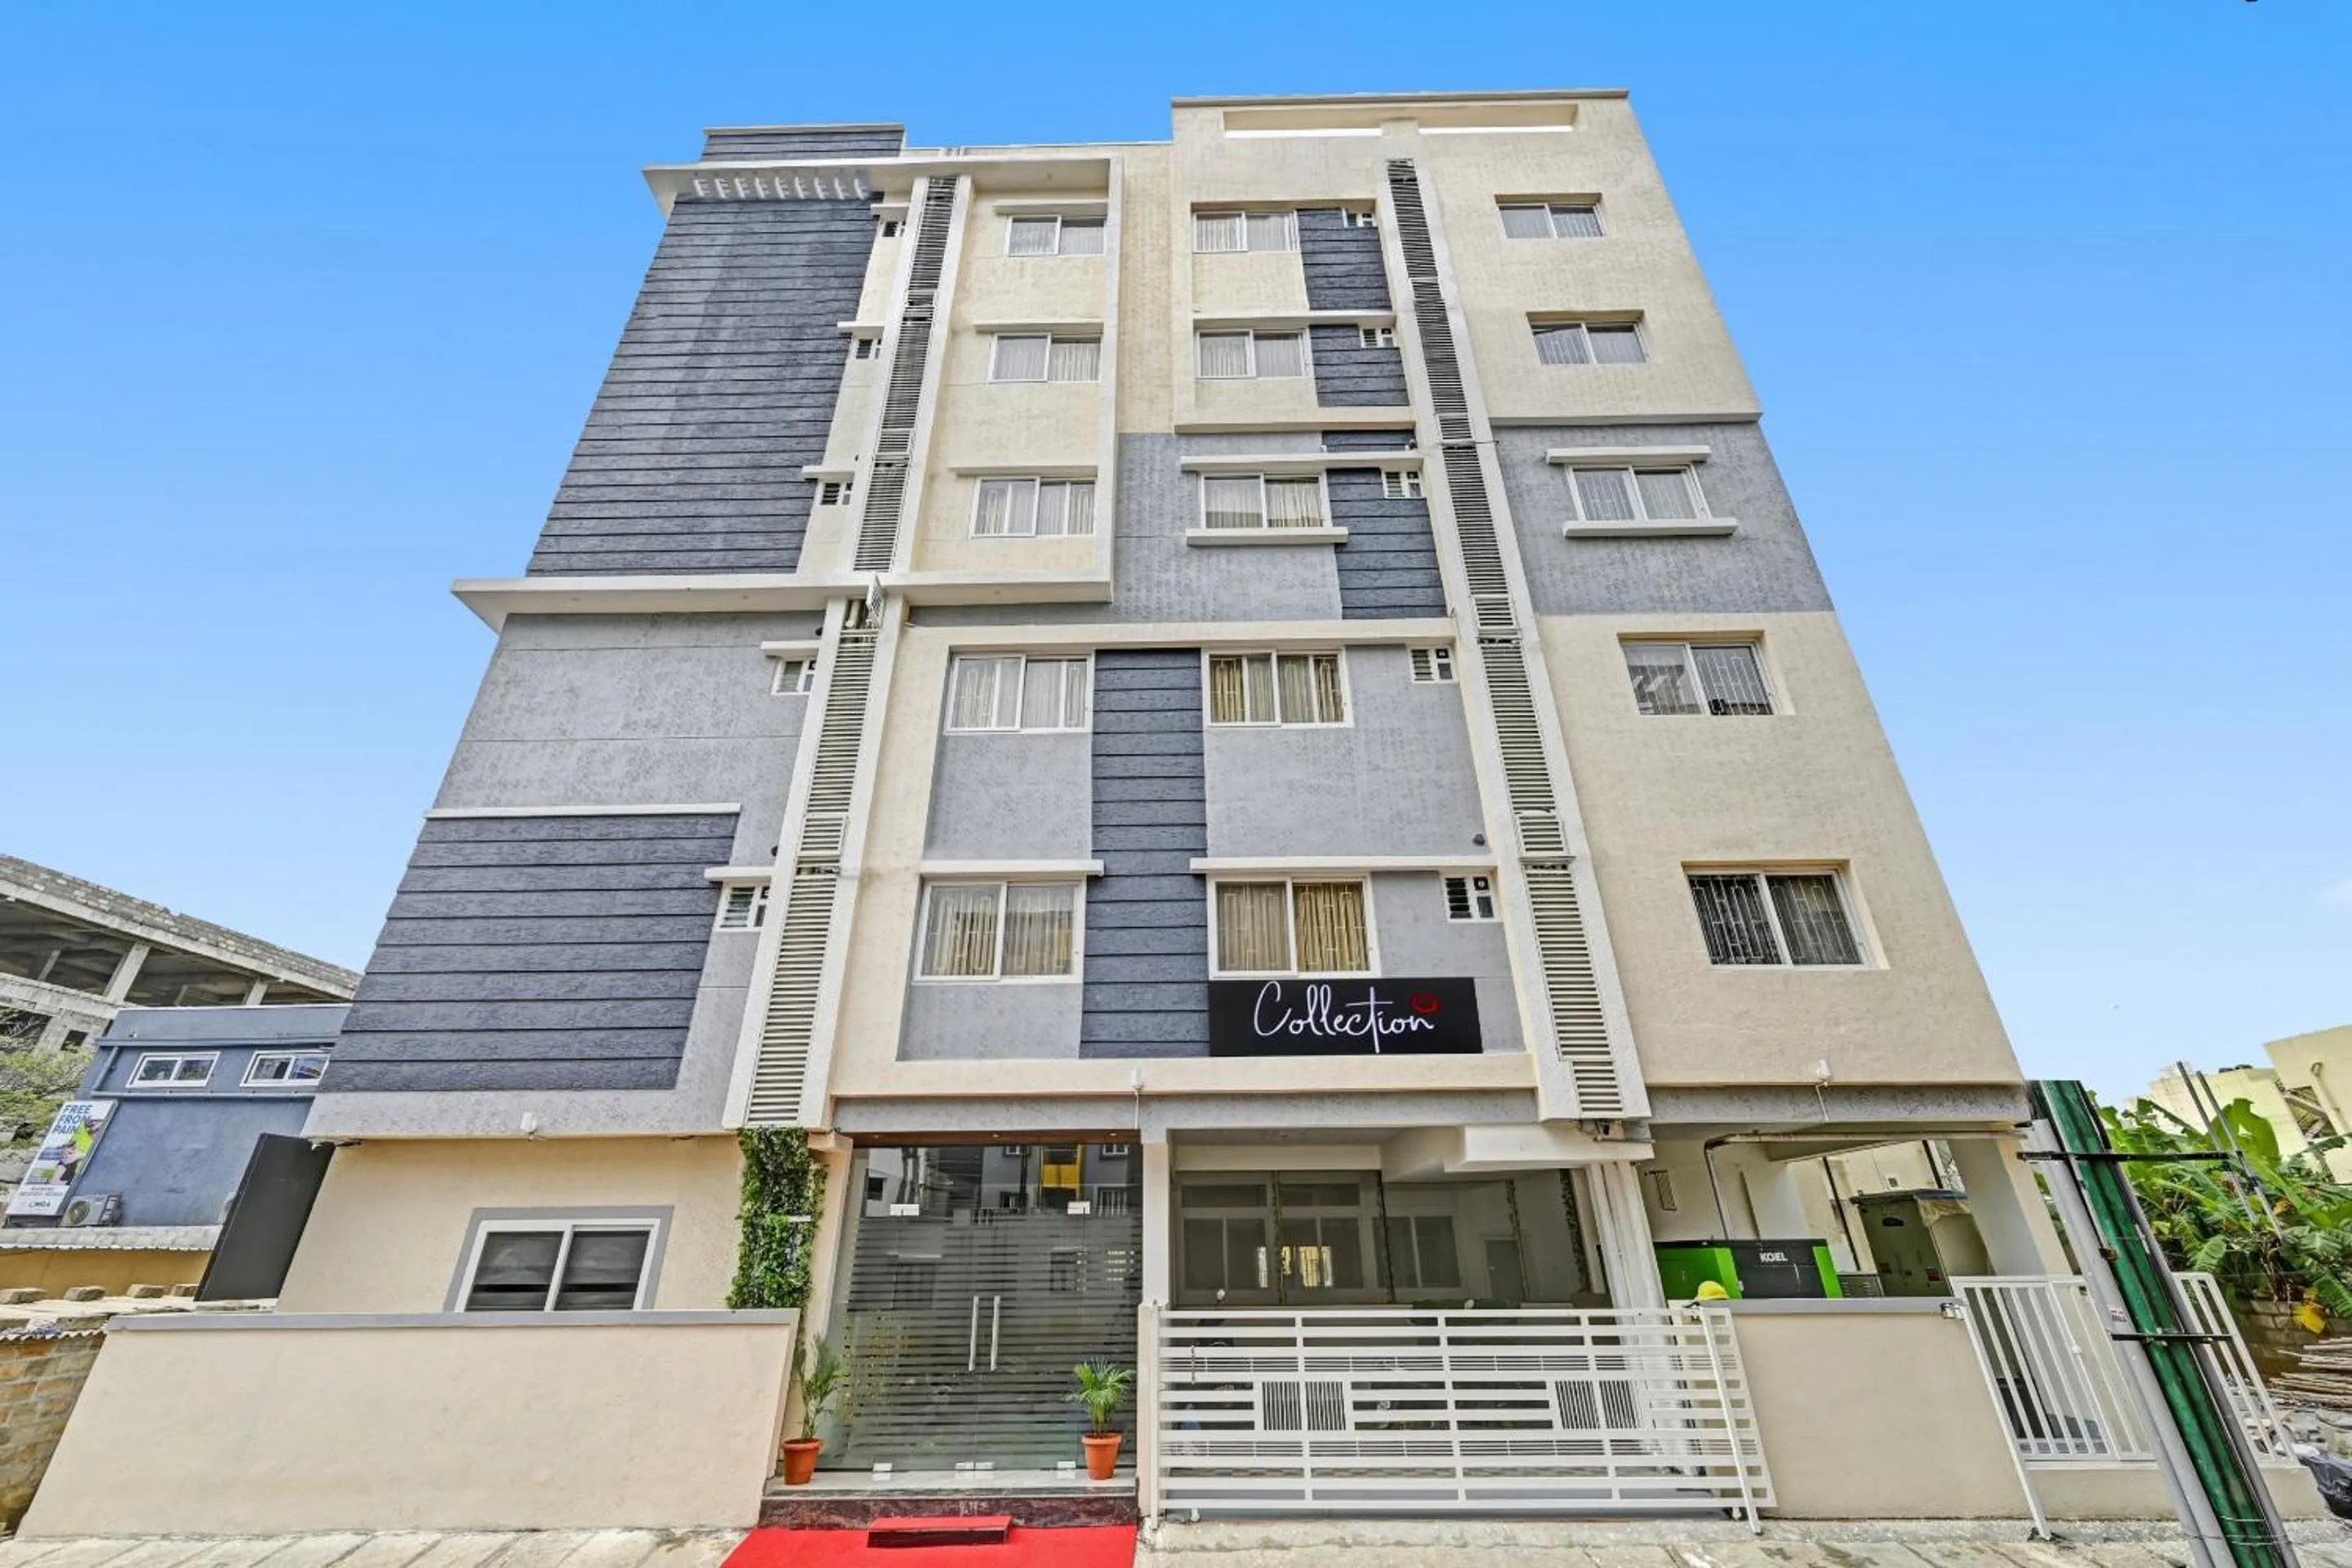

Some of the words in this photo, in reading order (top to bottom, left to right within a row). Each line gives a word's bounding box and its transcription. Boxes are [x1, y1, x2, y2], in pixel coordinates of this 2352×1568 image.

[1254, 981, 1434, 1054] Collection
[63, 1105, 93, 1114] FREE
[1759, 1252, 1788, 1262] KOEL
